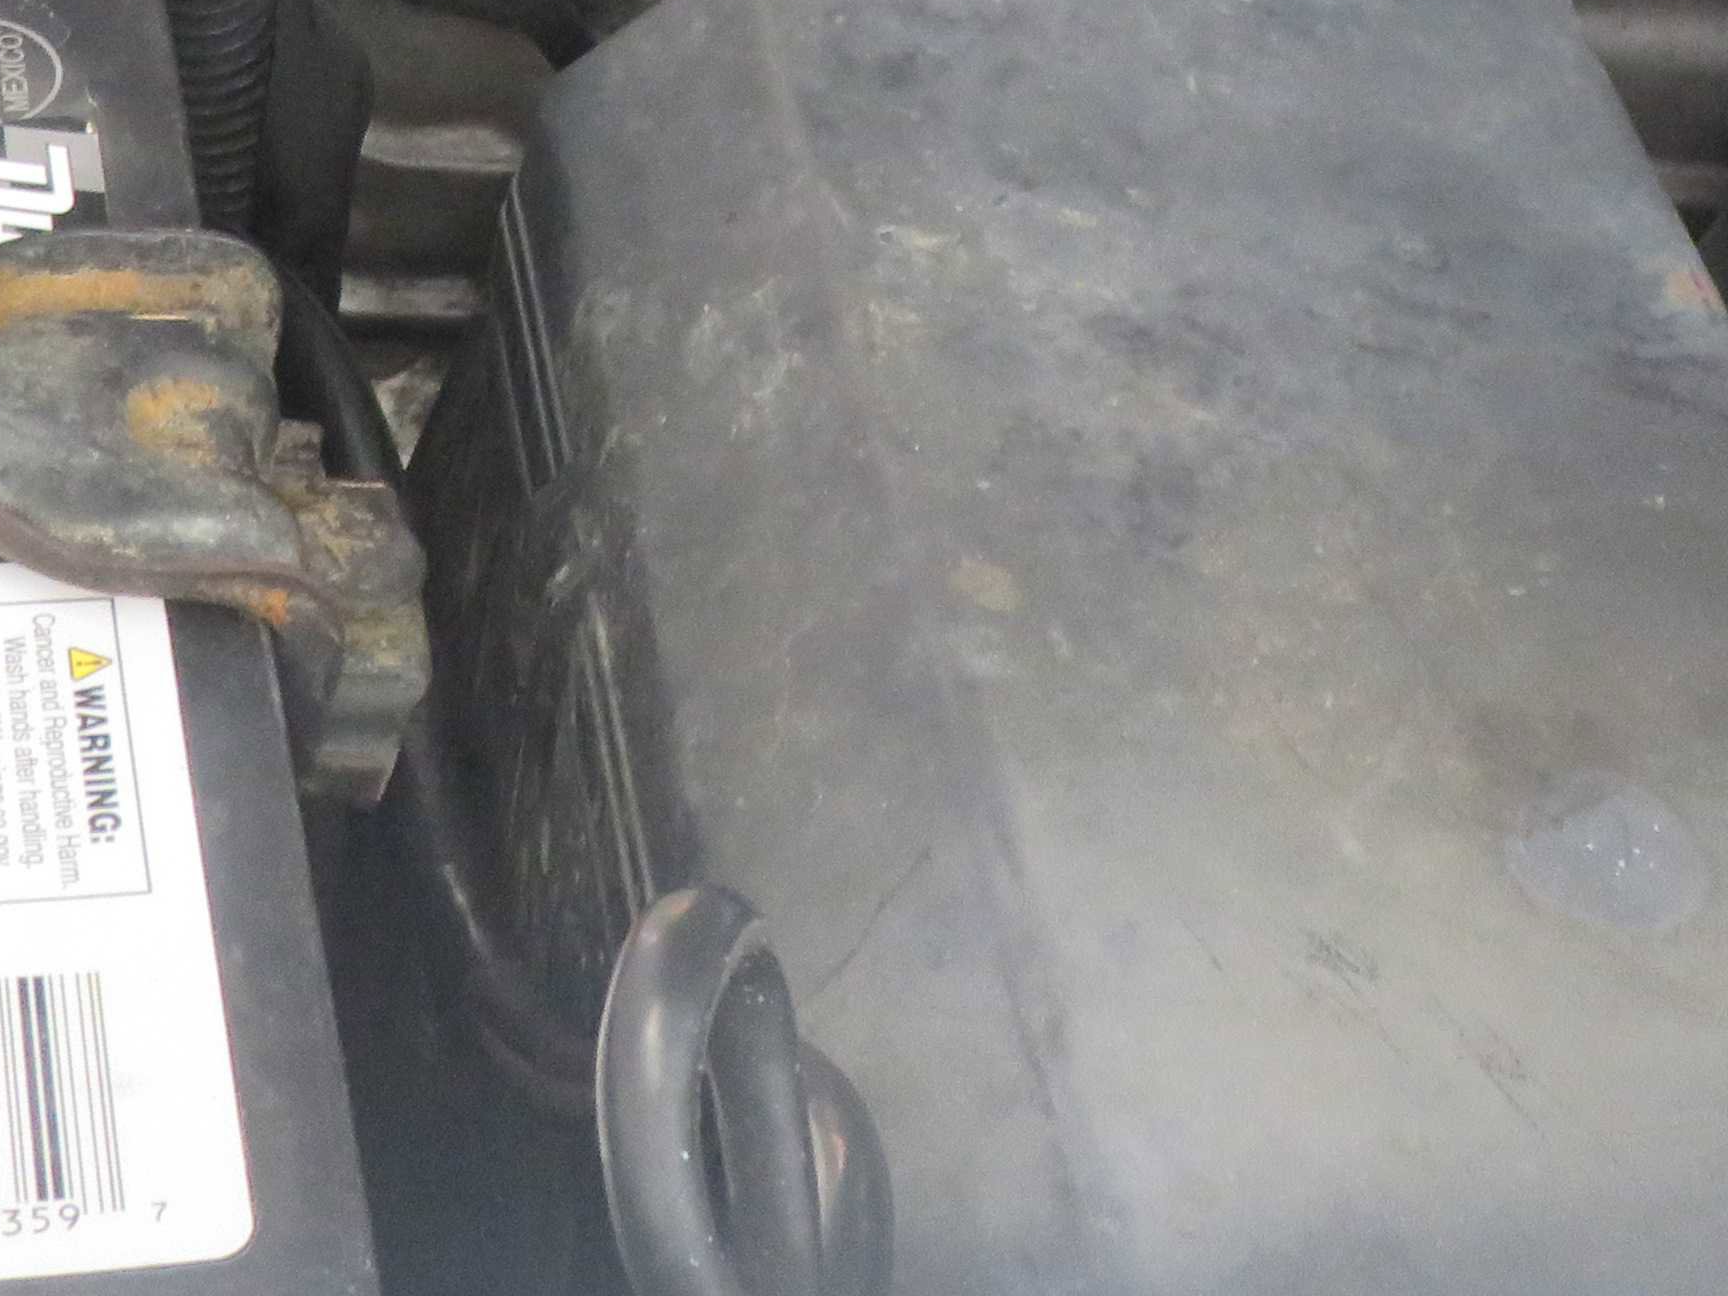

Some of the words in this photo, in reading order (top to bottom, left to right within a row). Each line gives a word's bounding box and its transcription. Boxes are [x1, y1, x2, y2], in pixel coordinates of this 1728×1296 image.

[3, 635, 28, 685] Wash
[32, 612, 56, 676] Cancer
[9, 688, 32, 743] hands
[39, 679, 60, 713] and
[15, 745, 39, 786] after
[39, 715, 76, 830] Reproductive
[73, 684, 122, 845] WARNING:
[19, 788, 48, 870] handling.
[56, 834, 82, 890] Harm.
[150, 1201, 168, 1223] 7
